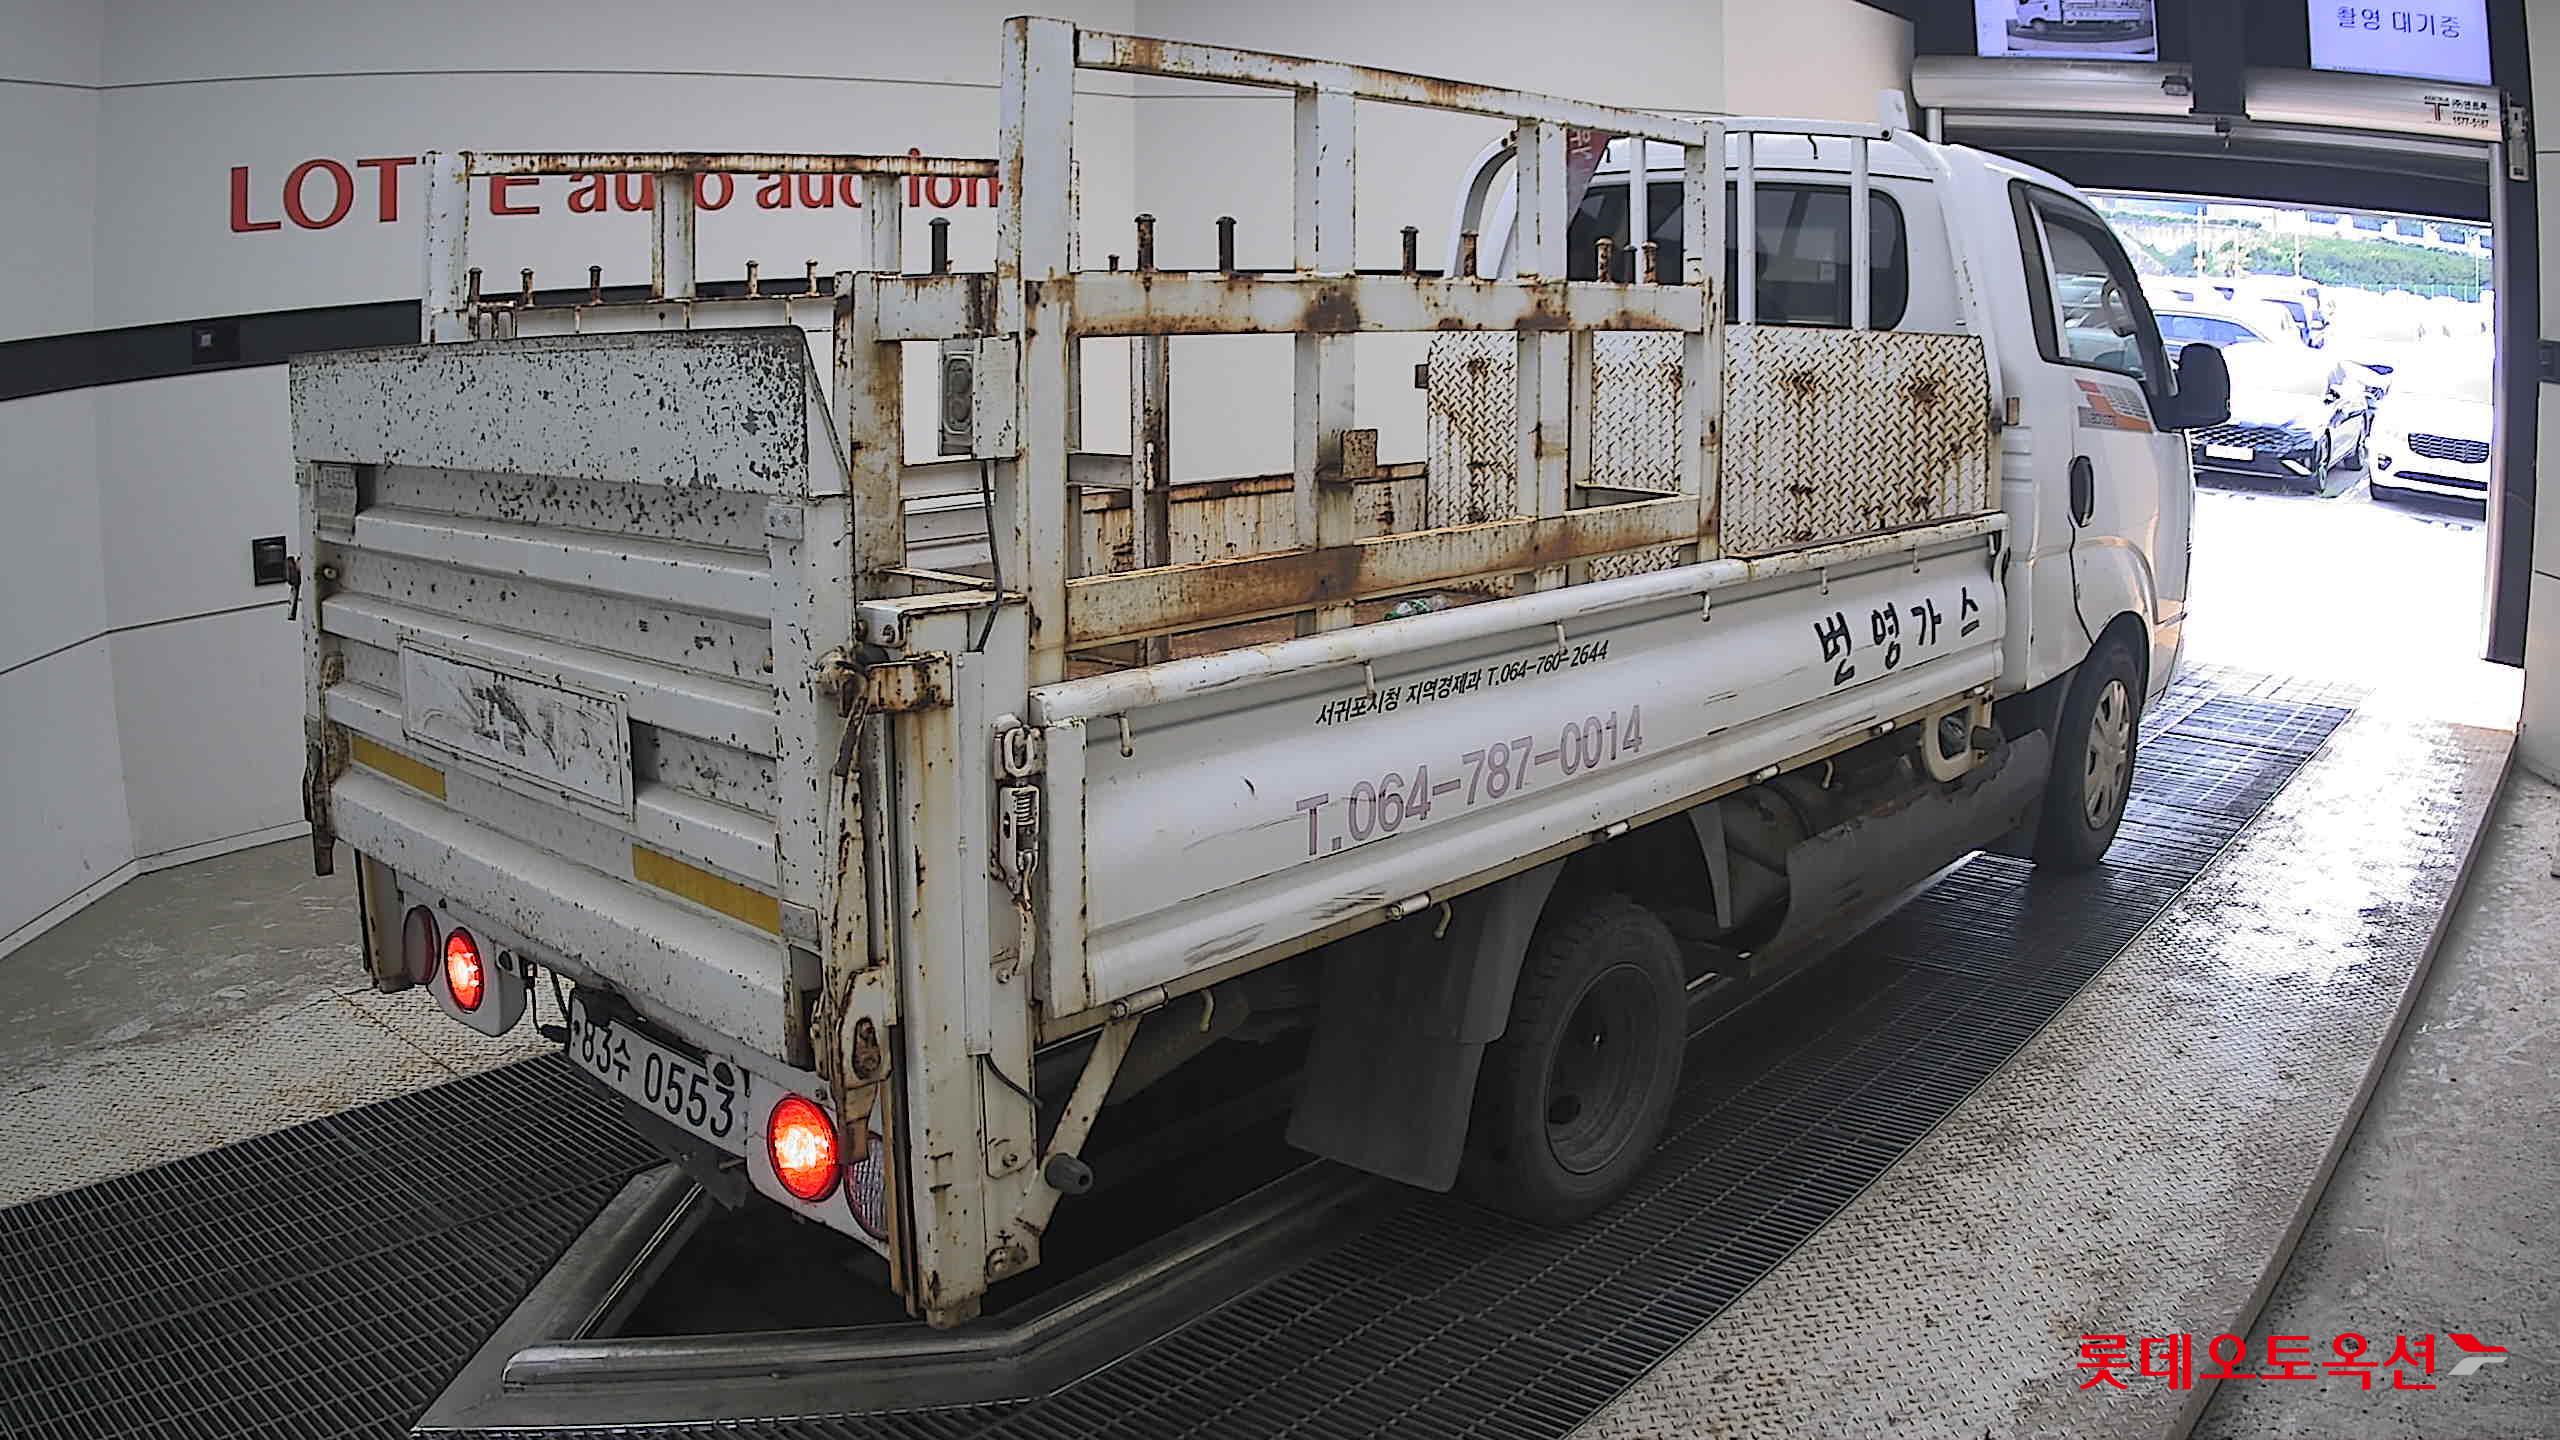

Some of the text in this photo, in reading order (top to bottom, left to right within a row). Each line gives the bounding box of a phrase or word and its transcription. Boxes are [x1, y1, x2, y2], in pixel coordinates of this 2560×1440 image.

[2338, 7, 2460, 39] 촬영 대기중
[231, 148, 1000, 232] LOTE auo aucion
[1316, 686, 1401, 726] 서귀포시청
[1406, 668, 1482, 705] 지역경제과
[1296, 704, 1643, 856] T.064-787-0014
[582, 1021, 736, 1138] 83수 0553
